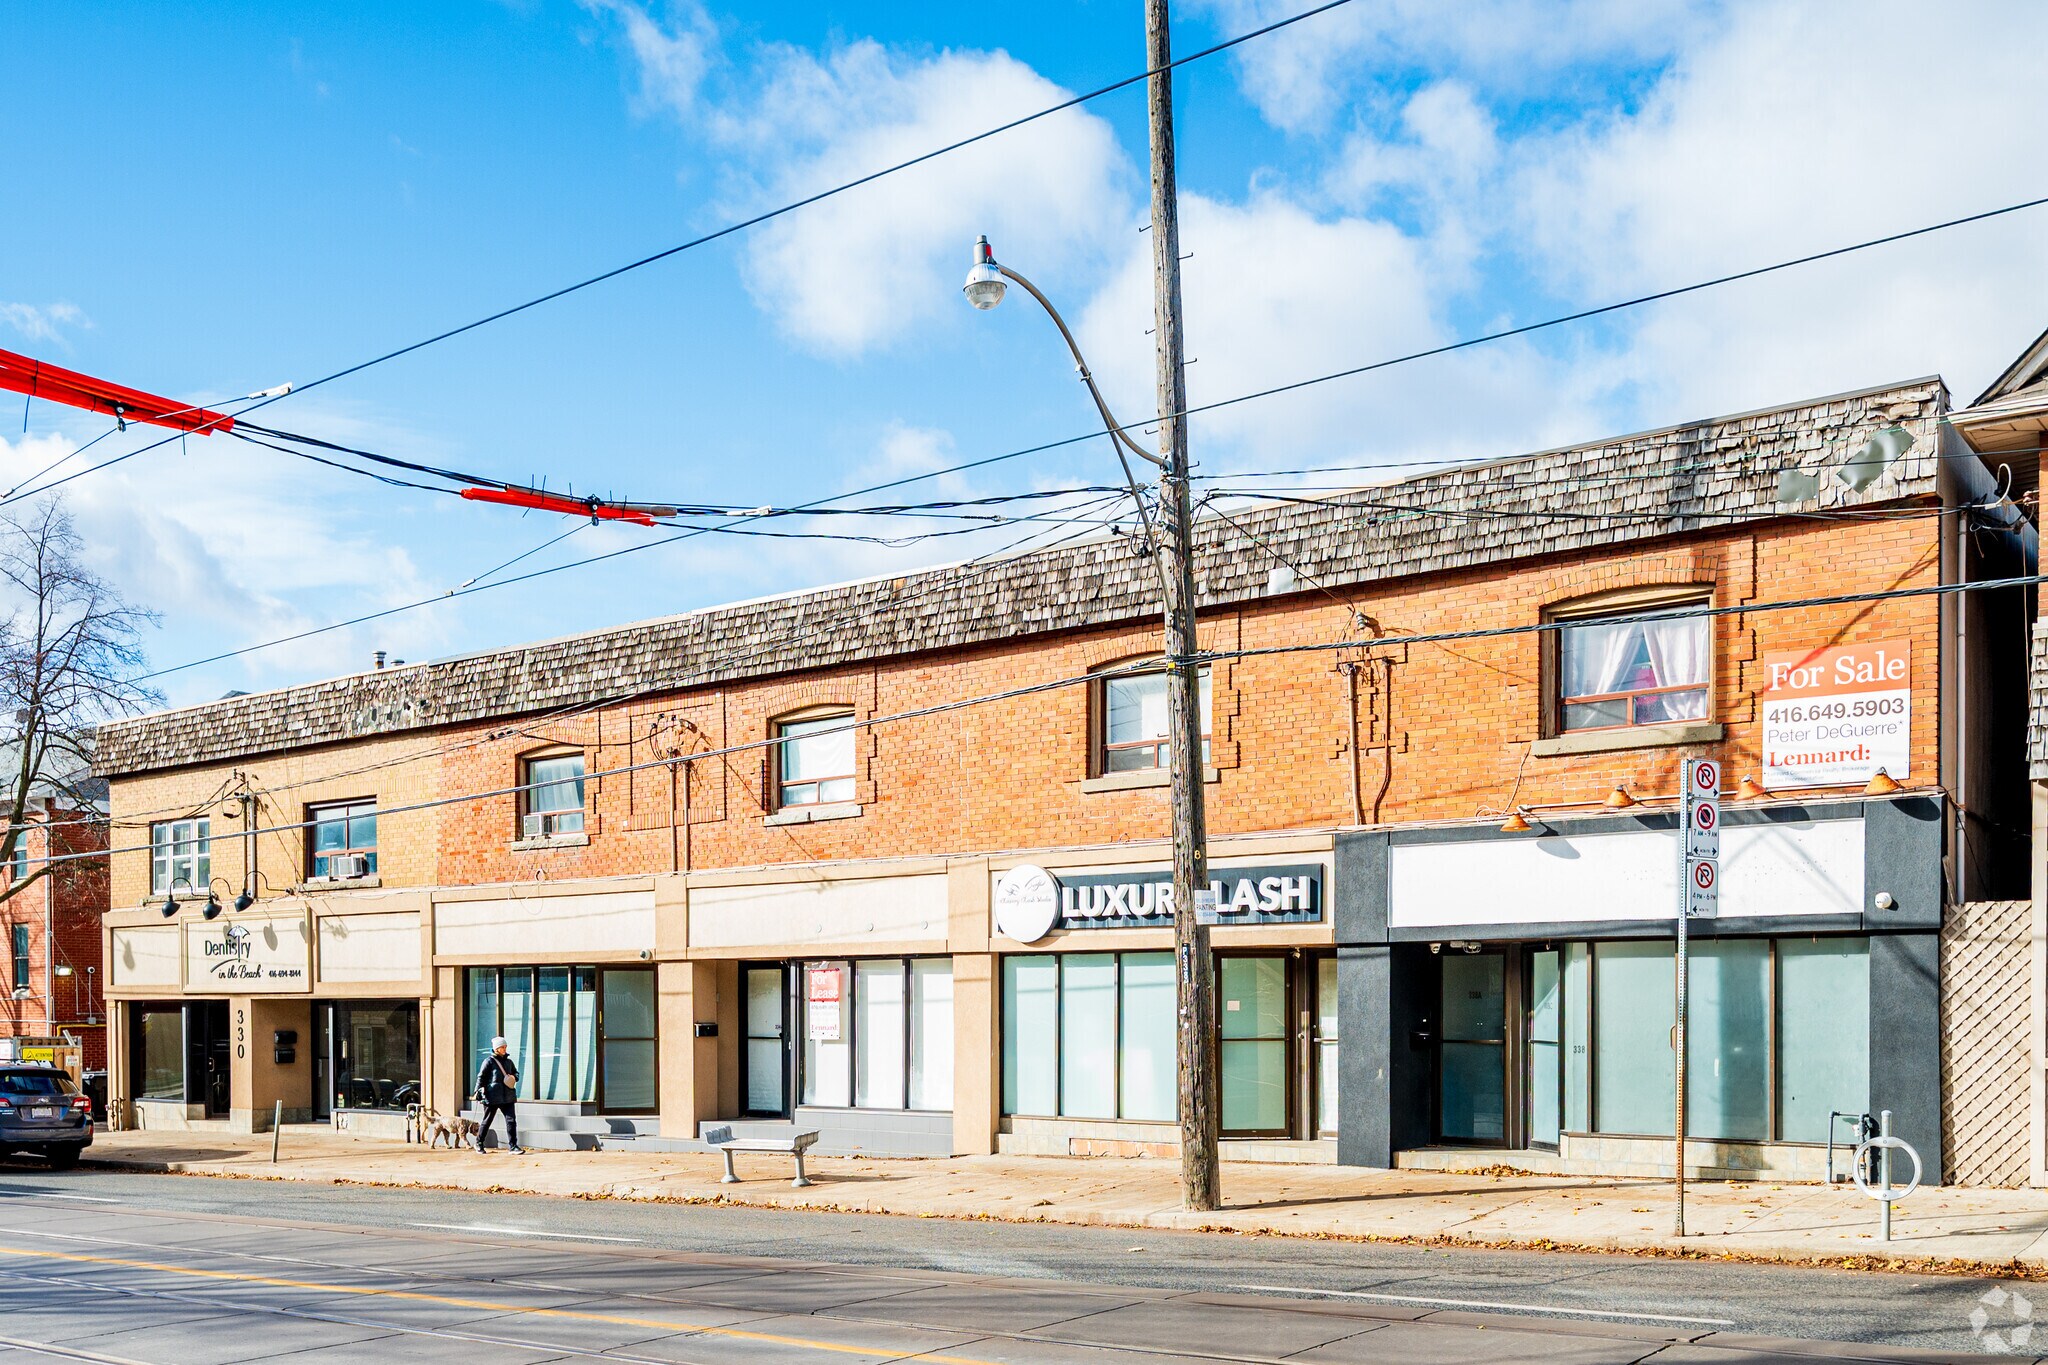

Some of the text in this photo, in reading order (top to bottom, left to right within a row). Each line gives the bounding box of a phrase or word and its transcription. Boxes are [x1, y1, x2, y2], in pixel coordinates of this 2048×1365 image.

[1768, 651, 1906, 691] For Sale
[1769, 698, 1904, 724] 416.649.5903
[1768, 728, 1811, 744] Peter
[1707, 828, 1711, 837] 9
[1194, 849, 1201, 860] 8
[1061, 875, 1312, 919] LUXUR LASH
[1706, 892, 1710, 900] 6
[1196, 903, 1216, 911] PAINTING
[205, 936, 251, 960] Dentistry
[218, 964, 262, 979] in the Beach
[811, 973, 827, 985] For
[811, 986, 838, 999] Lease
[237, 1009, 245, 1060] 330
[1573, 1045, 1585, 1054] 338
